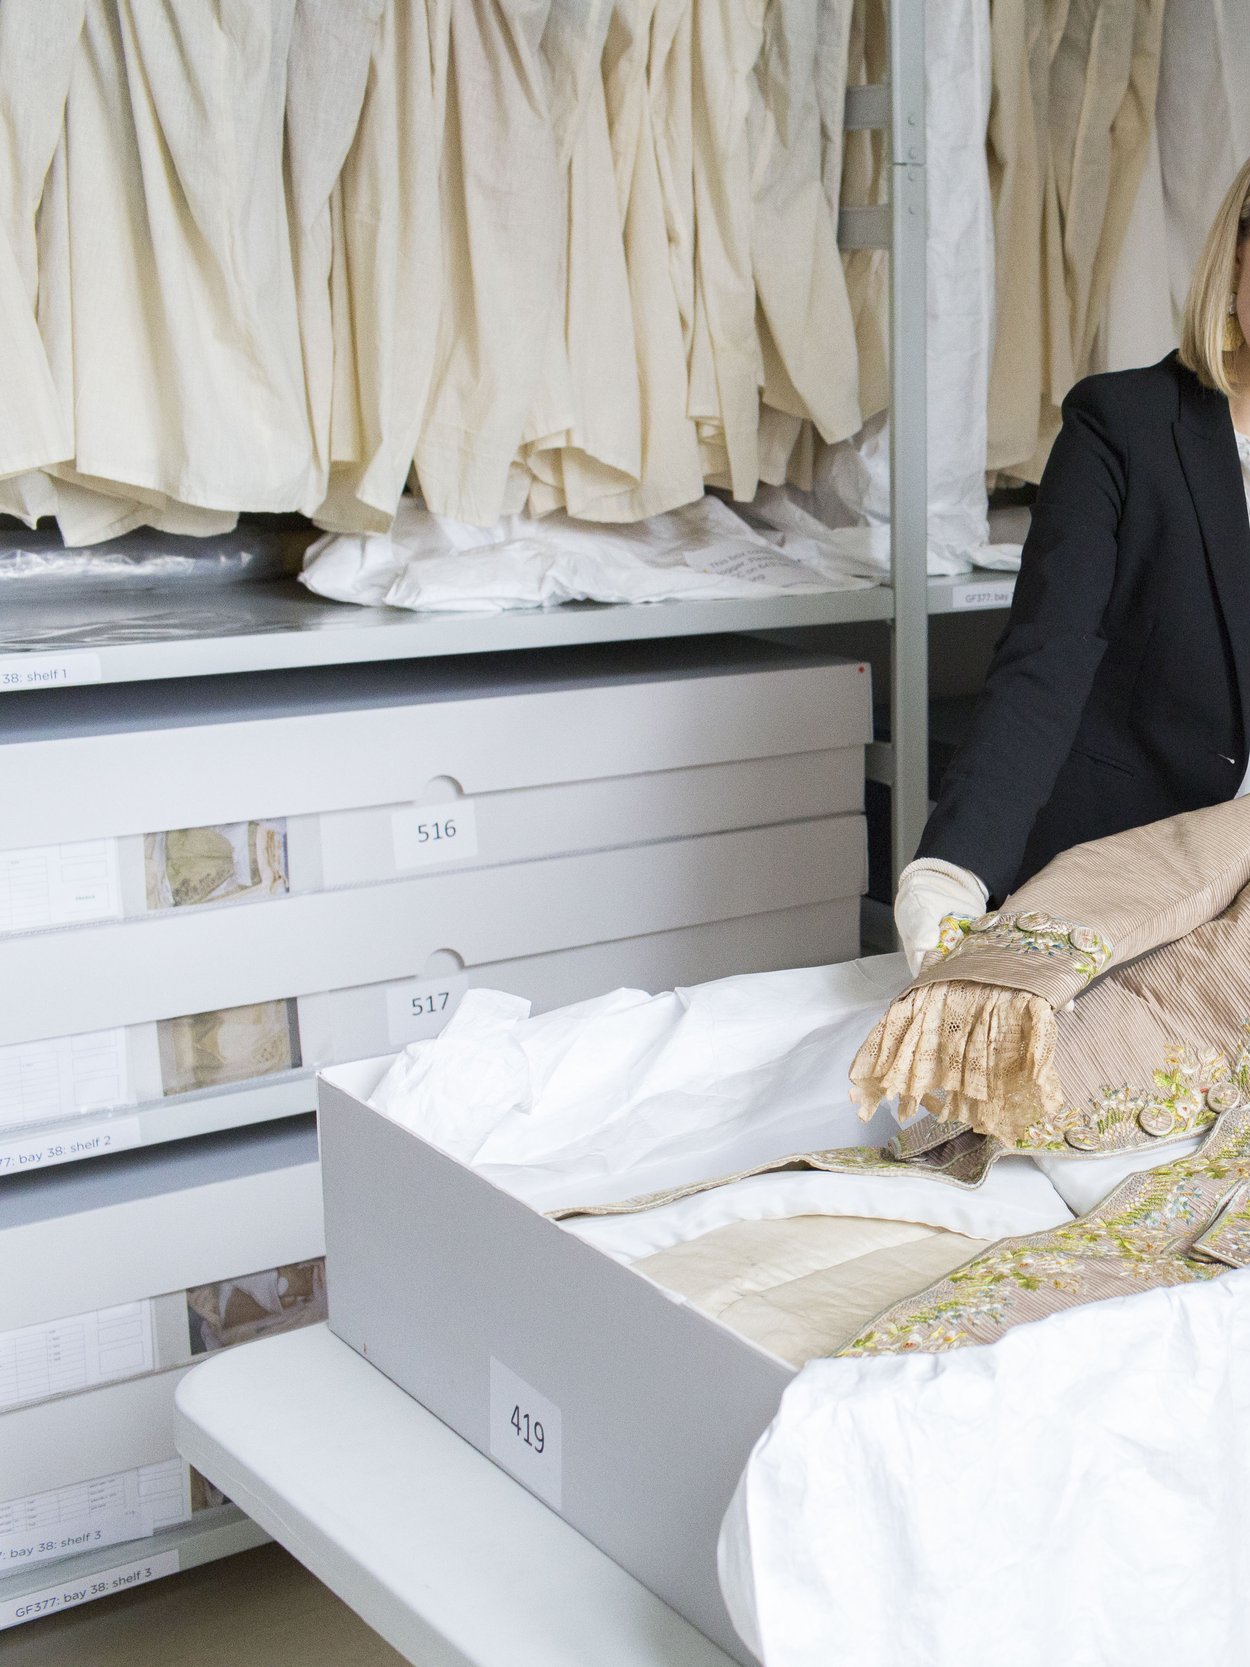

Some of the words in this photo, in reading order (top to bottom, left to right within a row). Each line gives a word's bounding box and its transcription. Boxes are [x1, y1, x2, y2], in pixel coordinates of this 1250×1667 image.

[2, 672, 22, 684] 38:
[27, 668, 58, 682] shelf
[62, 668, 67, 679] 1
[418, 819, 457, 843] 516
[412, 992, 450, 1016] 517
[19, 1151, 43, 1165] bay
[47, 1146, 66, 1158] 38:
[70, 1137, 100, 1153] shelf
[103, 1135, 112, 1146] 2
[510, 1404, 545, 1454] 419
[10, 1547, 34, 1559] bay
[39, 1541, 57, 1552] 38:
[61, 1532, 91, 1548] shelf
[94, 1530, 102, 1541] 3
[15, 1597, 60, 1618] GF377:
[64, 1589, 87, 1604] bay
[90, 1583, 109, 1595] 38:
[112, 1571, 142, 1588] shelf
[144, 1567, 153, 1578] 3
